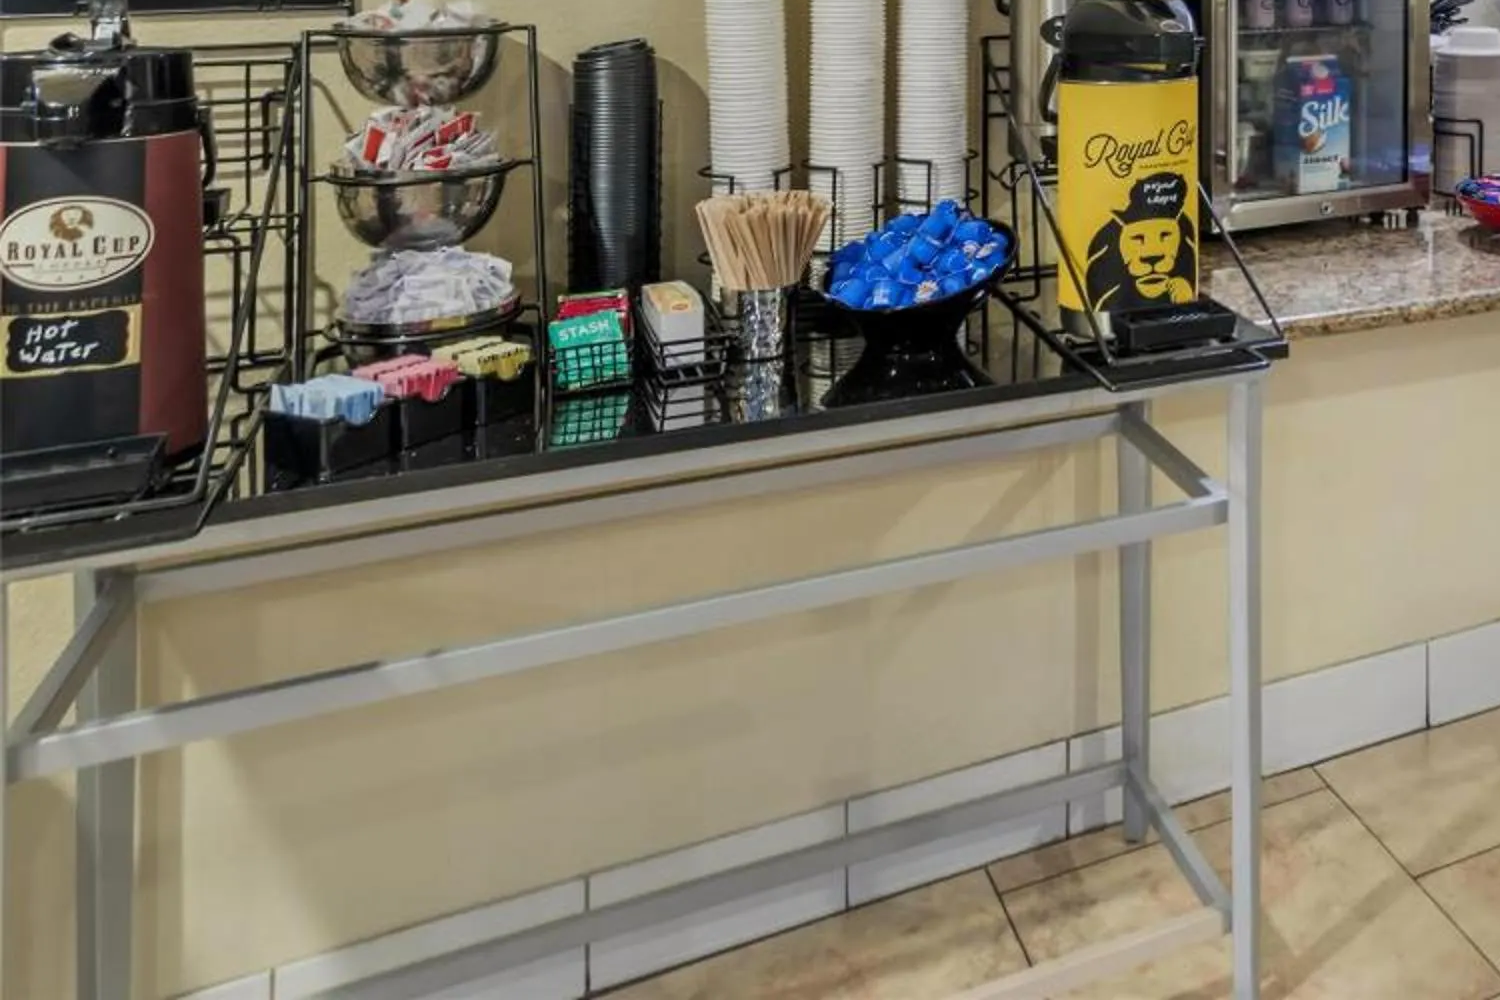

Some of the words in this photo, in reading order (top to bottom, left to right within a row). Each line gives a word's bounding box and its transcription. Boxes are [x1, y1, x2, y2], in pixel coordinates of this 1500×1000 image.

[1298, 96, 1350, 137] Silk
[1084, 129, 1164, 178] Royal
[7, 240, 83, 262] ROYAL
[92, 236, 141, 256] CUP
[558, 319, 610, 342] STASH
